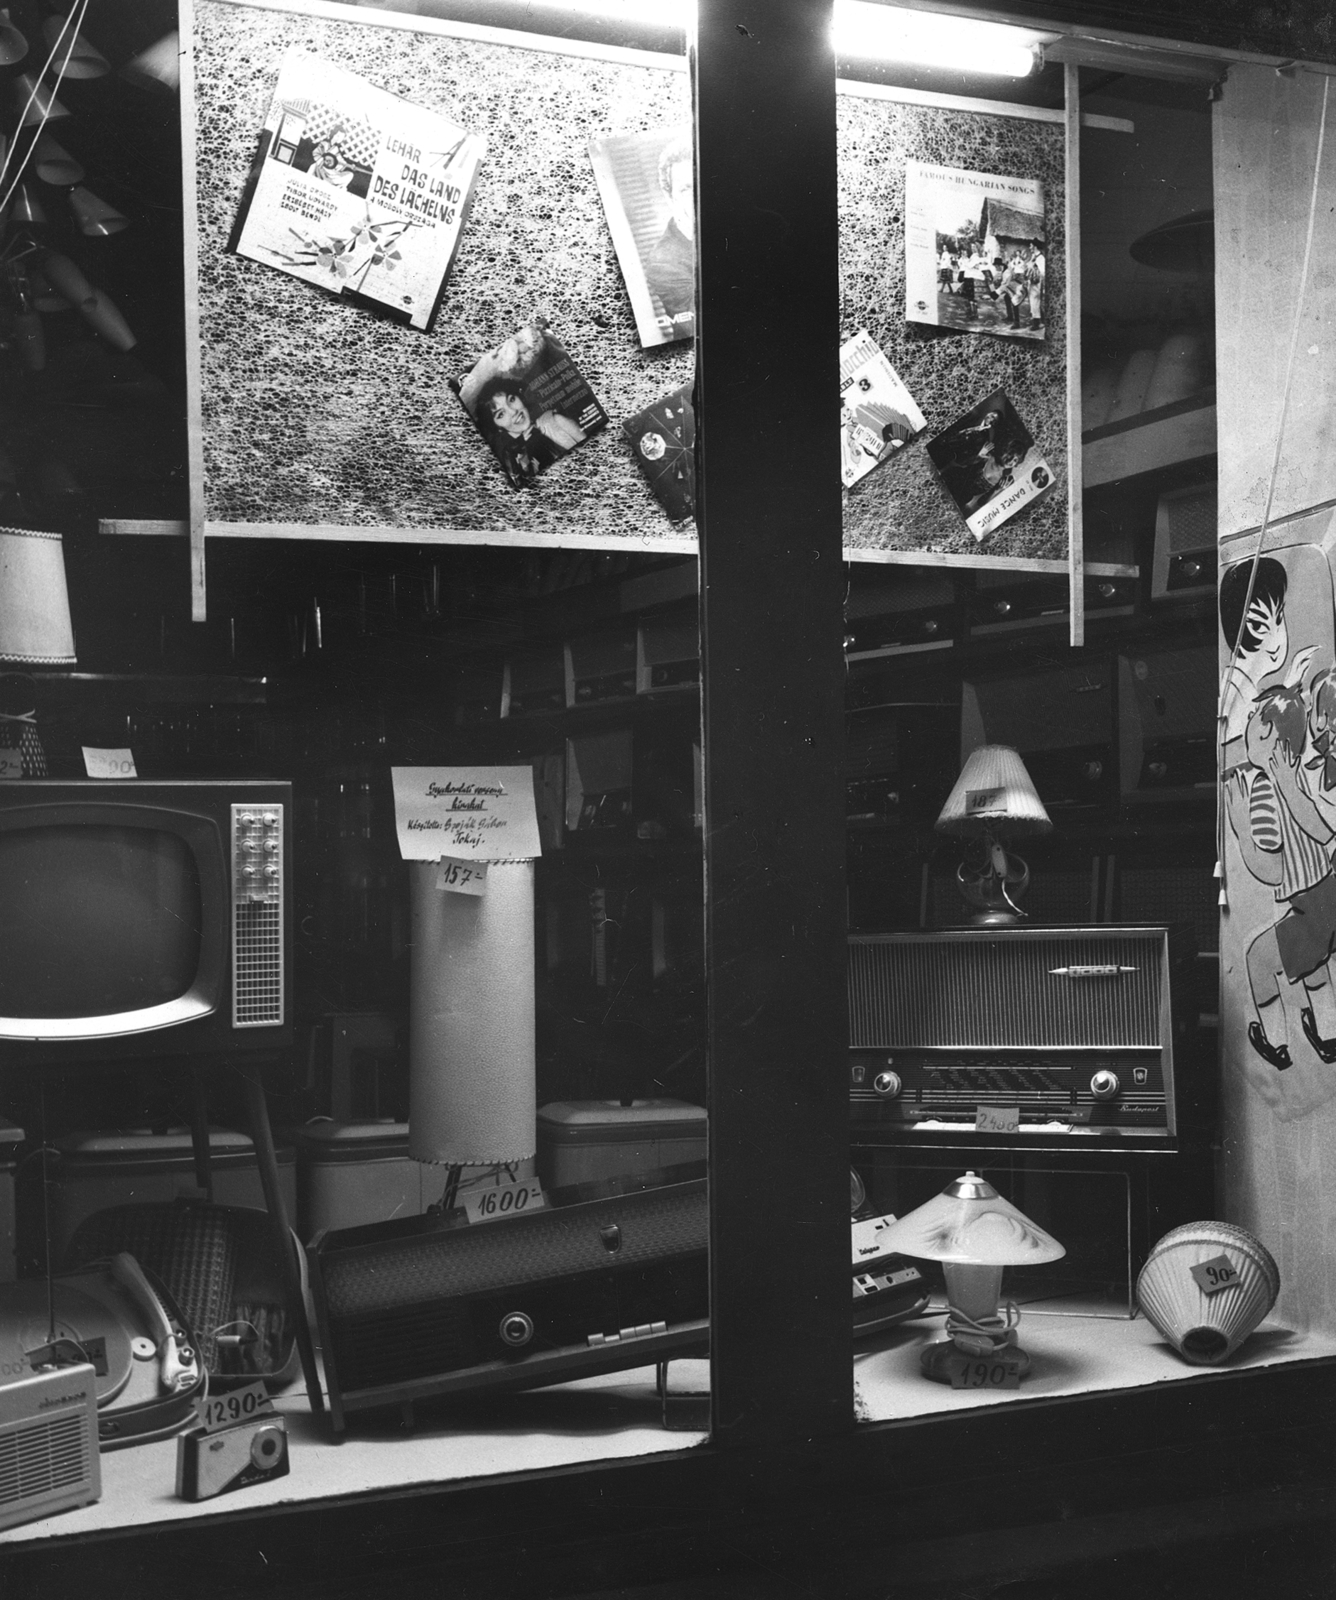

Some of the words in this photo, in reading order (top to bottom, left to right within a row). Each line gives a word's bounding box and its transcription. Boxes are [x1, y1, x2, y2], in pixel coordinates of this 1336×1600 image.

[401, 164, 428, 189] DAS
[429, 177, 462, 205] LAND
[919, 170, 953, 182] FAMOUS
[955, 176, 1006, 190] HUNGARIAN
[1007, 185, 1036, 195] SONGS
[373, 175, 399, 200] DES
[399, 186, 456, 226] LÄCHELNS
[546, 358, 571, 378] STRAUSS
[859, 378, 871, 391] 3
[999, 487, 1026, 510] DANCE
[976, 507, 1000, 528] MUSIC
[1118, 1104, 1160, 1114] Budapest
